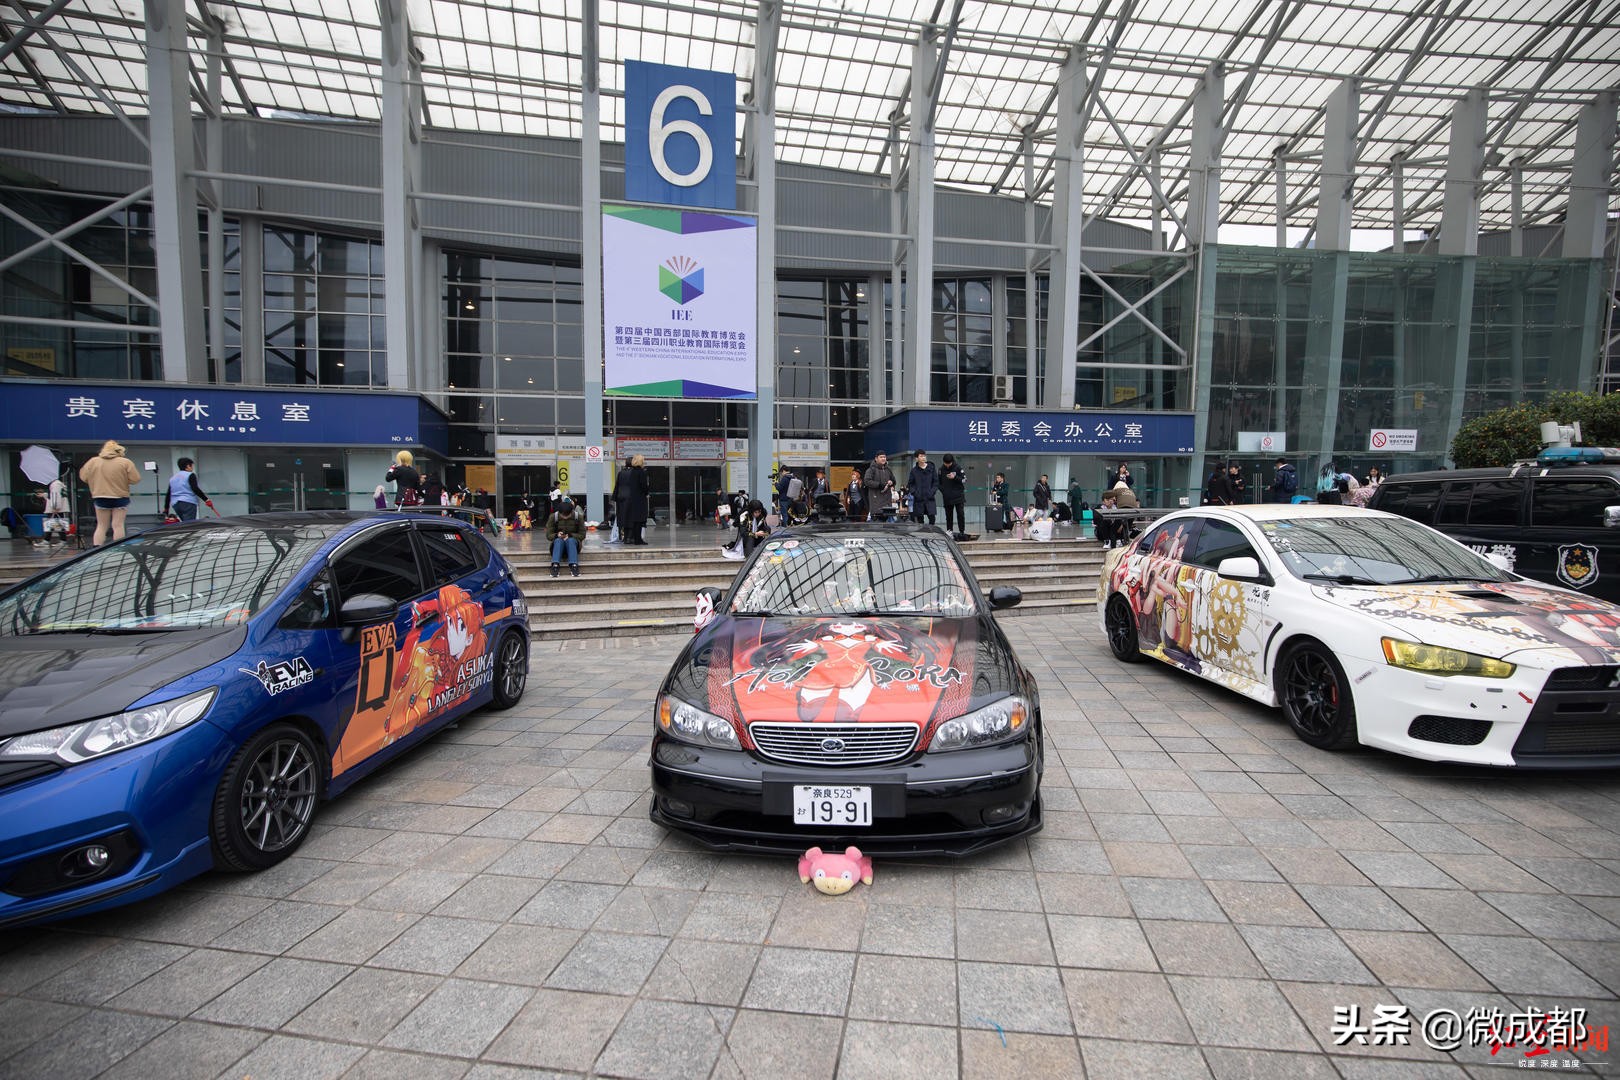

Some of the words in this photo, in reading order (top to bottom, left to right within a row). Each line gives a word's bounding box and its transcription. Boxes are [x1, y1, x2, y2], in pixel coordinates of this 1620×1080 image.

[648, 84, 714, 187] 6
[671, 309, 693, 321] IEE
[615, 326, 746, 340] 第四届中国西部国际教育博览会
[615, 336, 746, 350] 暨第三届四川职业教育国际博览会
[65, 396, 310, 422] 贵宾休息室
[196, 424, 257, 433] Lounge
[968, 420, 1142, 437] 组委会办公室
[558, 468, 568, 481] 6
[362, 624, 396, 654] EVA
[268, 656, 312, 684] EVA
[456, 652, 494, 684] ASUKA
[272, 672, 313, 694] RACING
[813, 788, 832, 798] 奈良
[834, 789, 852, 798] 529
[811, 801, 867, 822] 19-91
